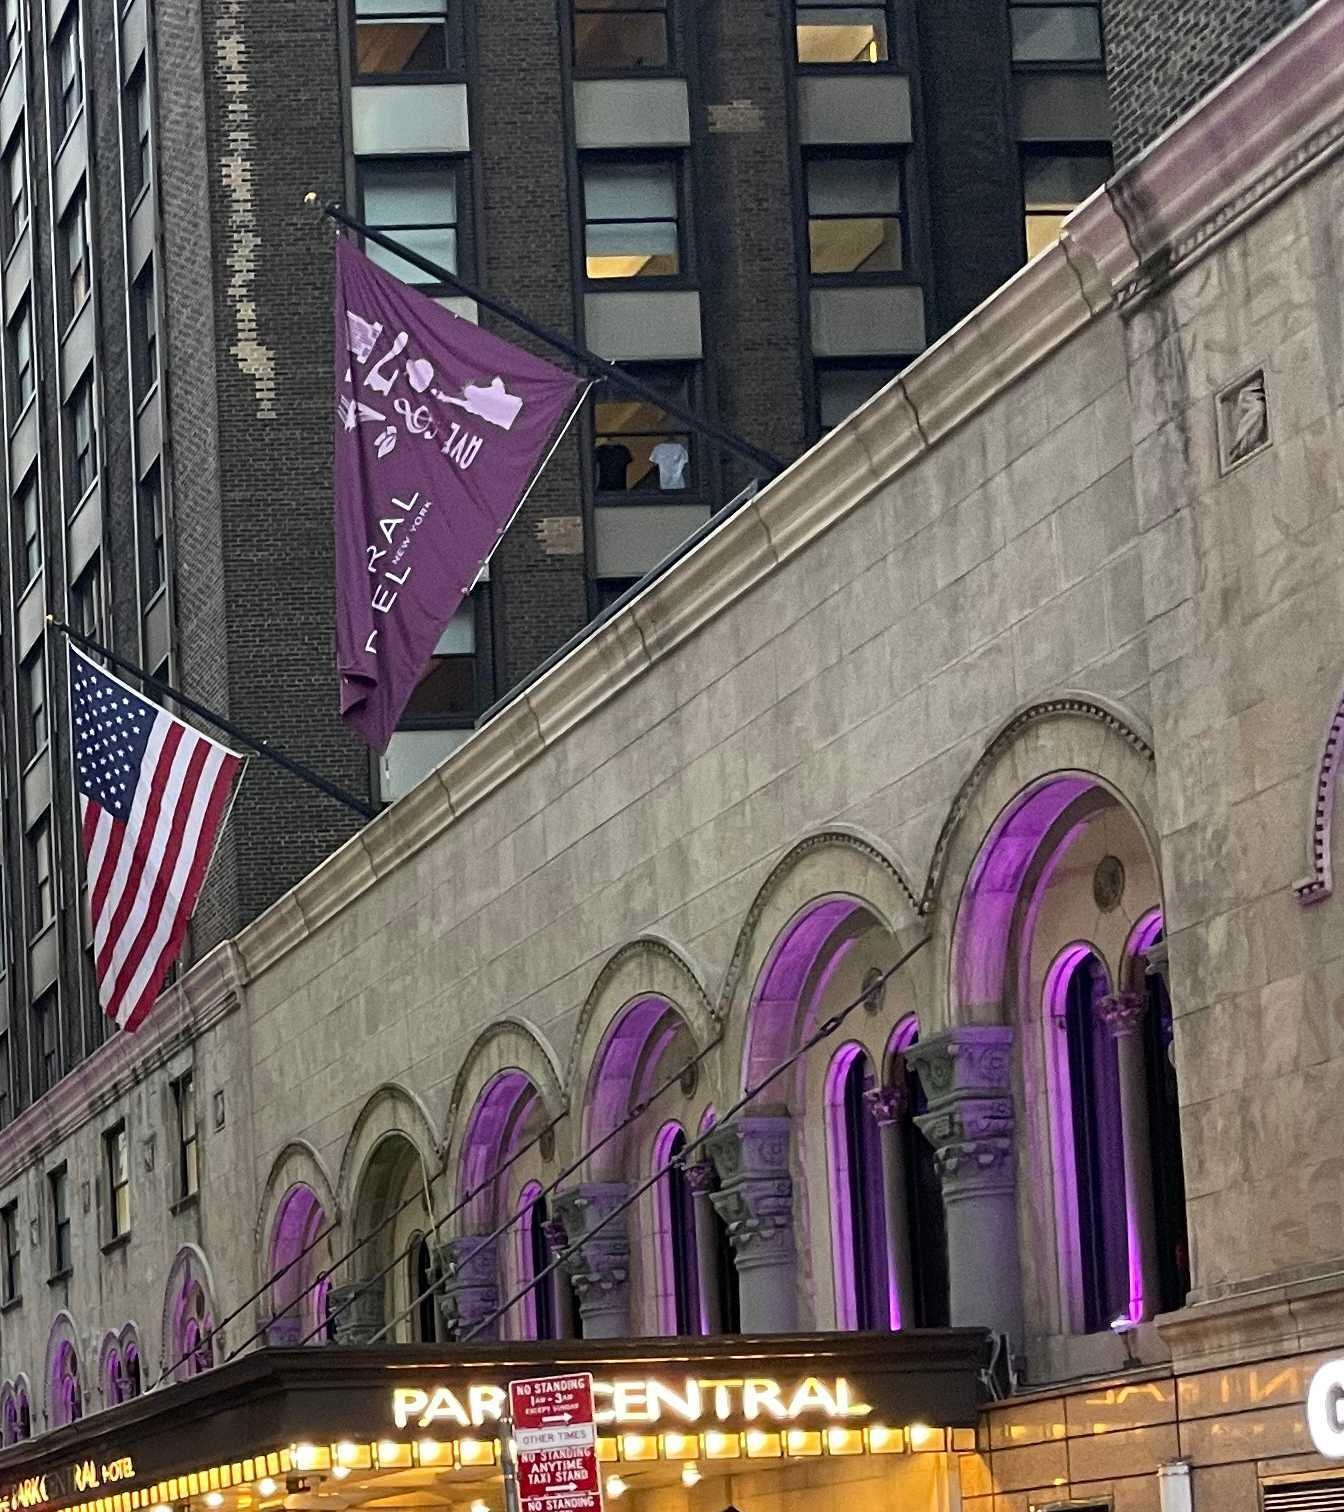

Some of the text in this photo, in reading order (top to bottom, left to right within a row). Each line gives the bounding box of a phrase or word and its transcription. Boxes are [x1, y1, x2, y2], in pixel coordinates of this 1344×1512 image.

[516, 1378, 585, 1396] NO STANDING
[394, 1386, 510, 1429] PAR
[525, 1405, 551, 1415] EXCEPT
[523, 1429, 587, 1445] OTHER TIMES
[521, 1447, 591, 1463] NO STANDING
[101, 1456, 135, 1484] HOTEL
[531, 1460, 583, 1474] ANYTIME
[527, 1469, 589, 1485] TAXI STAND
[528, 1496, 595, 1512] NO STANDING
